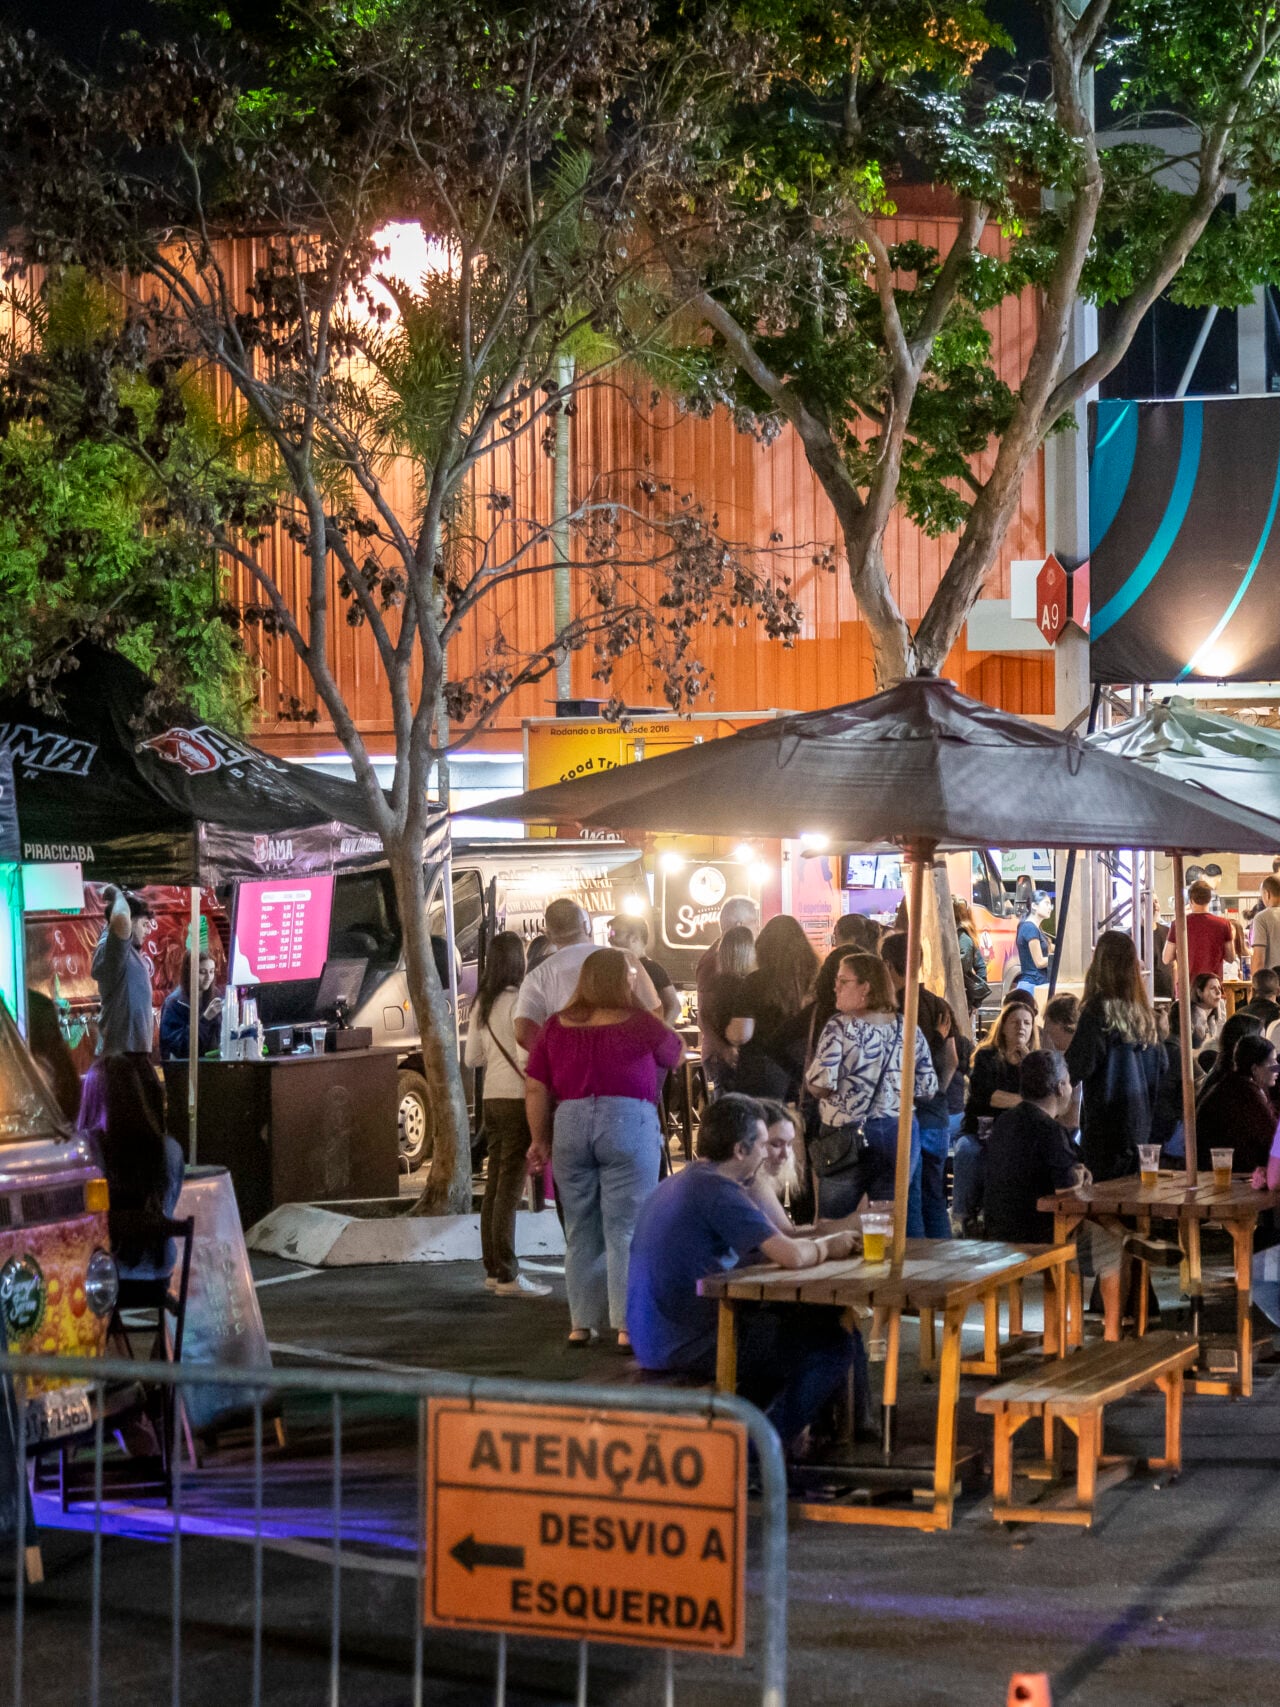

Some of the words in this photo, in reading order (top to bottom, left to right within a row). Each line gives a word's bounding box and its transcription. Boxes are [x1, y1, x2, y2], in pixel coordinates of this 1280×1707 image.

[1041, 603, 1059, 630] A9
[550, 727, 589, 736] Rodando
[597, 726, 621, 735] Brasil
[650, 725, 670, 733] 2016
[559, 758, 594, 783] Food
[24, 843, 95, 861] PIRACICABA
[469, 1429, 705, 1496] ATENÇÃO
[539, 1512, 687, 1558] DESVIO
[700, 1527, 727, 1563] A
[510, 1578, 725, 1634] ESQUERDA
